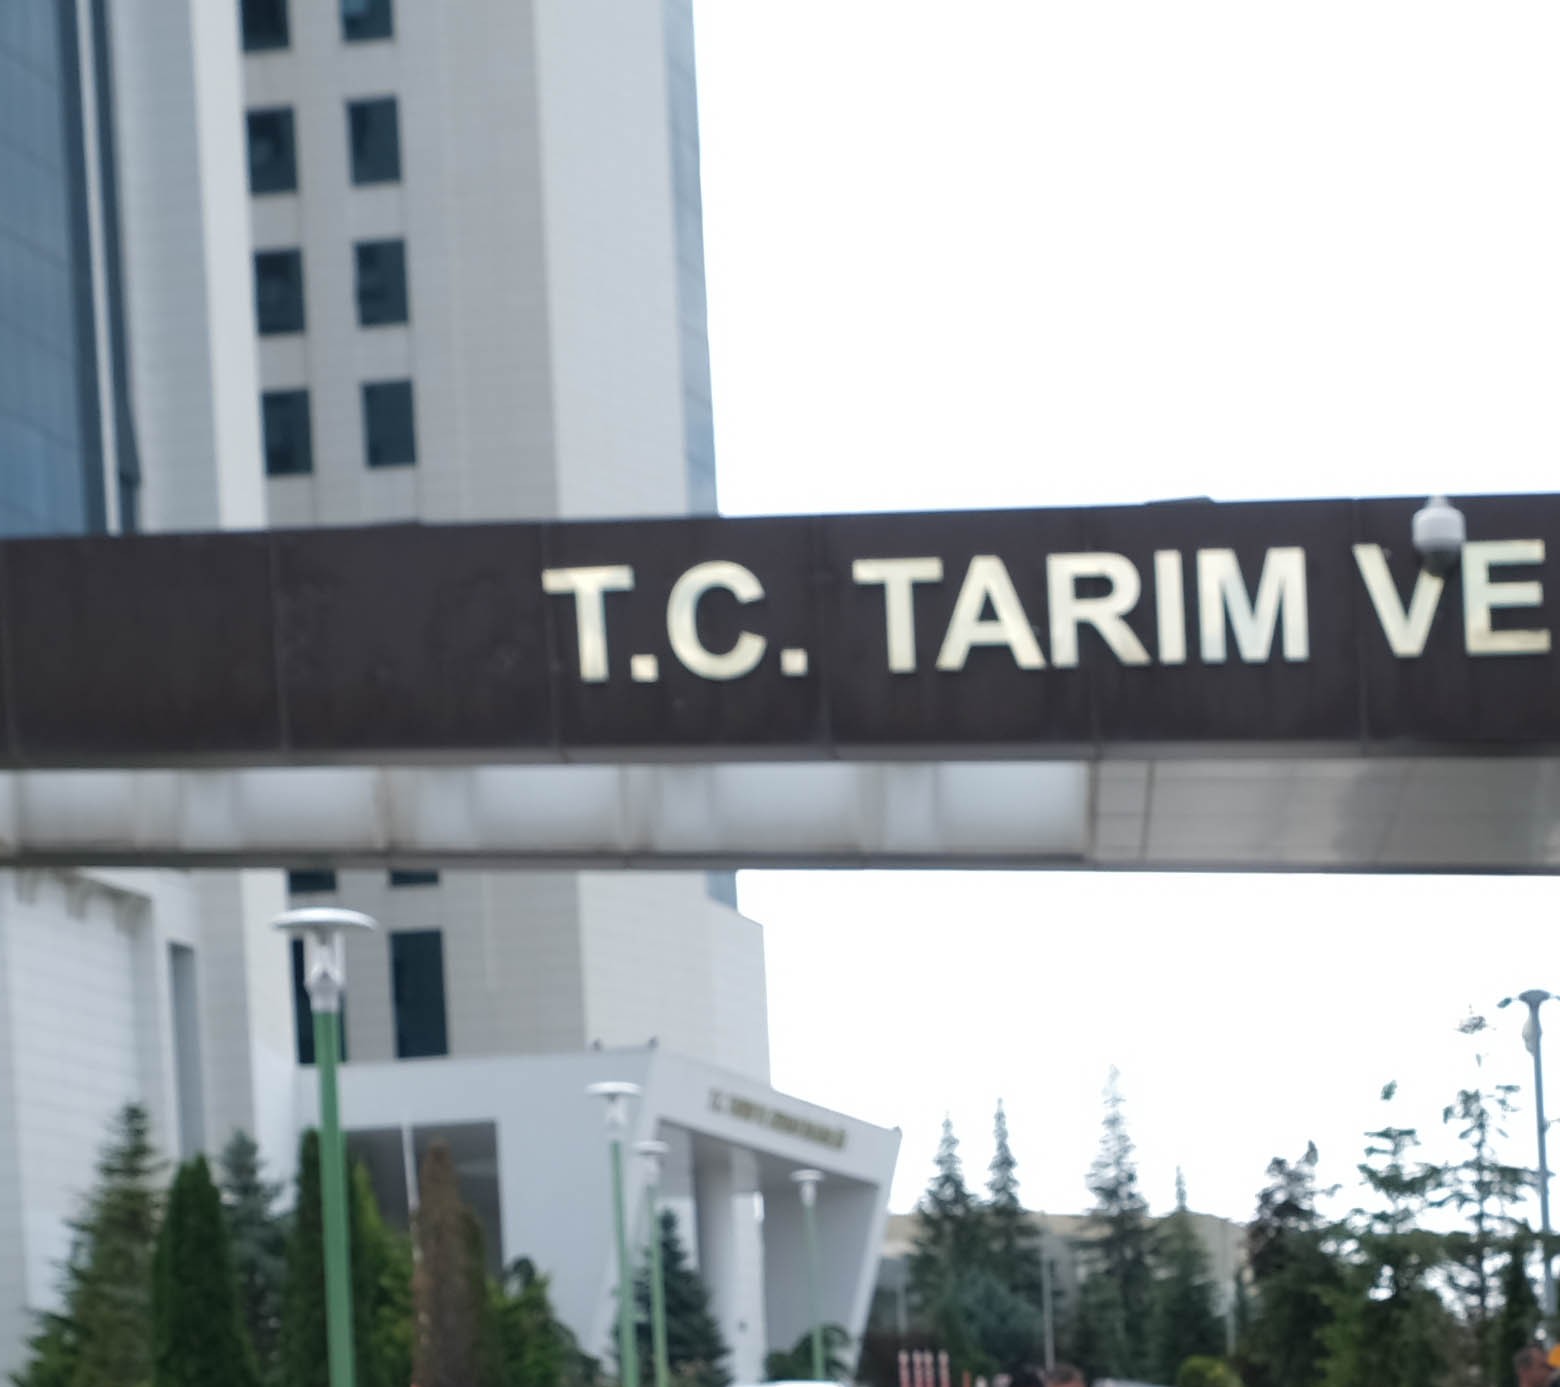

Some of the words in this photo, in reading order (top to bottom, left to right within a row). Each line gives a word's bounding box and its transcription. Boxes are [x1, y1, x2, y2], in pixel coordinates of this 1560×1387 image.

[543, 561, 808, 683] T.C.
[852, 547, 1310, 675] TARIM
[1353, 539, 1551, 660] VE
